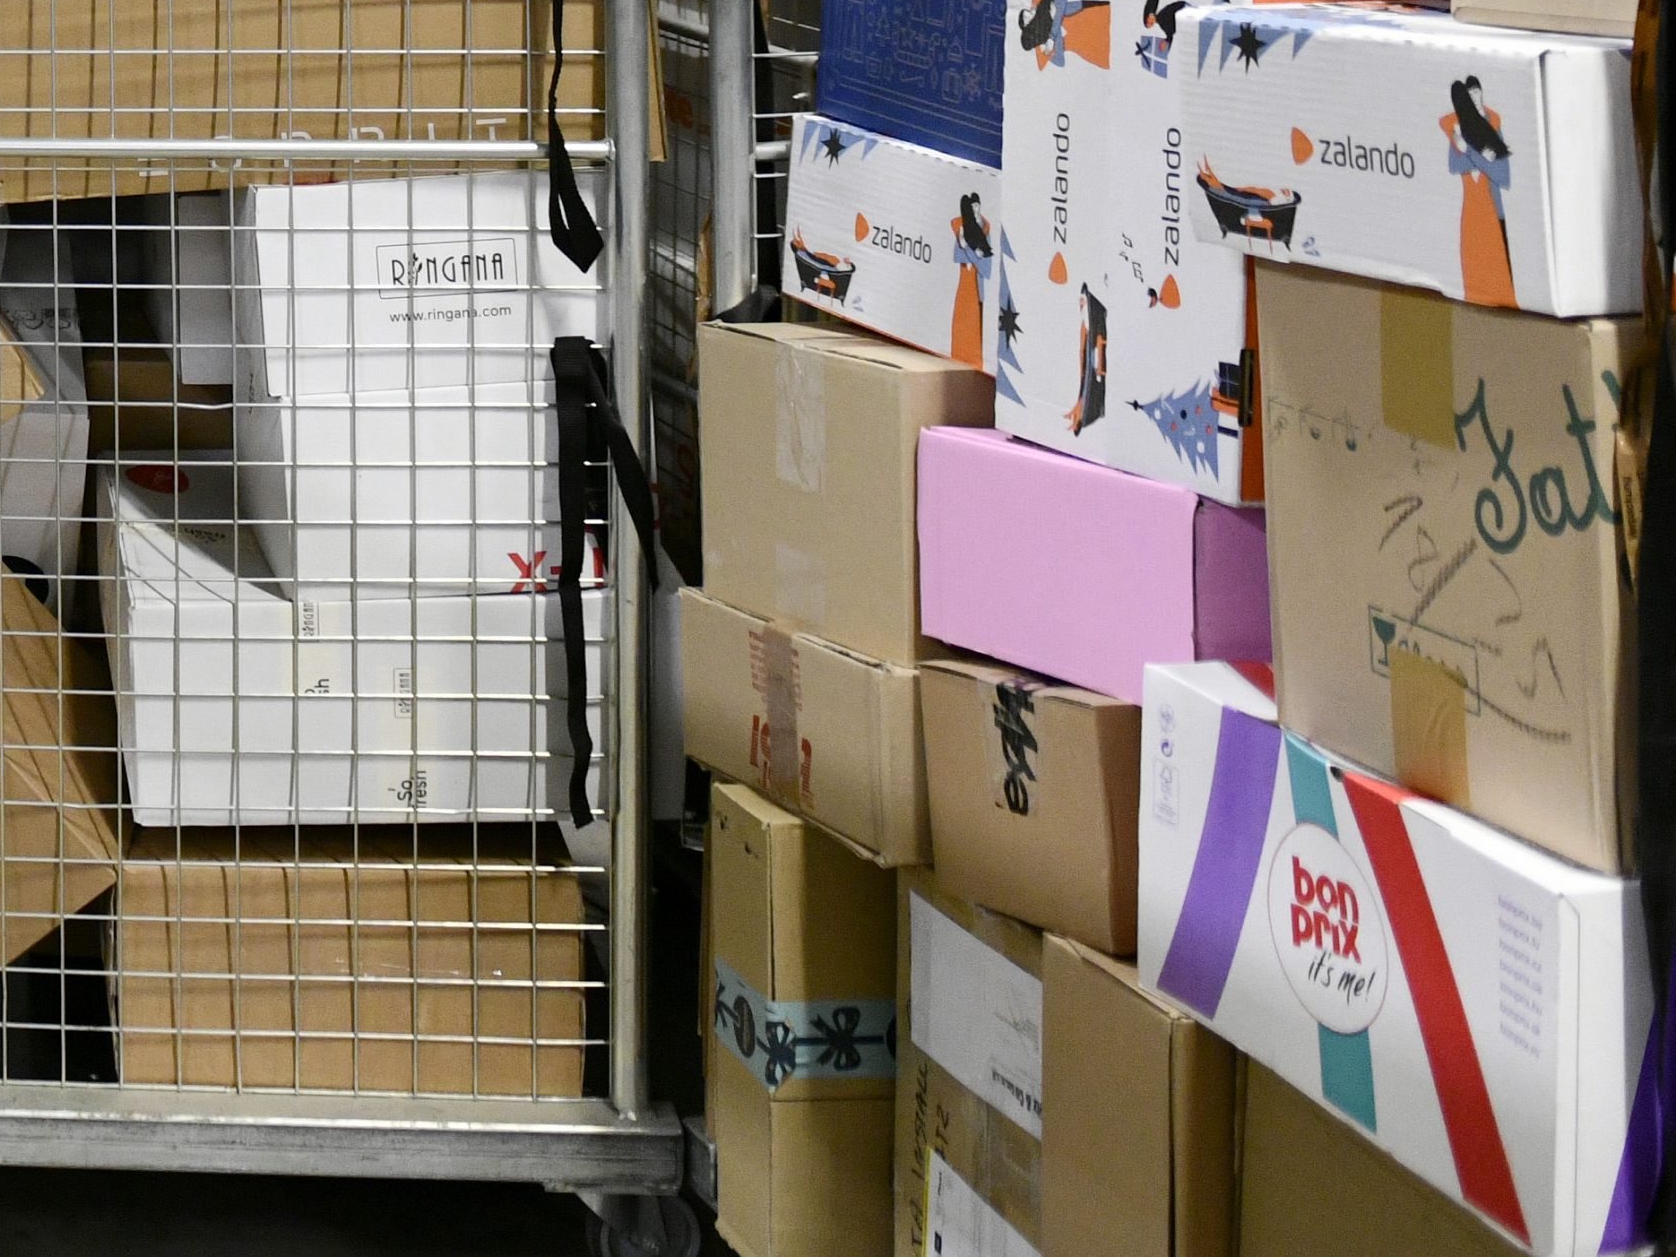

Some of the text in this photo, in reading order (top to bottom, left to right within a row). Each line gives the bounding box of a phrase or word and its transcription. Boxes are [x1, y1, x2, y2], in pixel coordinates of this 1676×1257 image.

[1051, 113, 1071, 244] zalando
[1321, 136, 1416, 180] zalando
[1162, 127, 1182, 266] zalando
[391, 252, 504, 286] RINGANA
[871, 224, 932, 265] zalando
[389, 304, 512, 323] www.ringana.com
[1291, 854, 1359, 925] bon
[1290, 902, 1362, 965] prix
[1307, 948, 1376, 1007] it's me!
